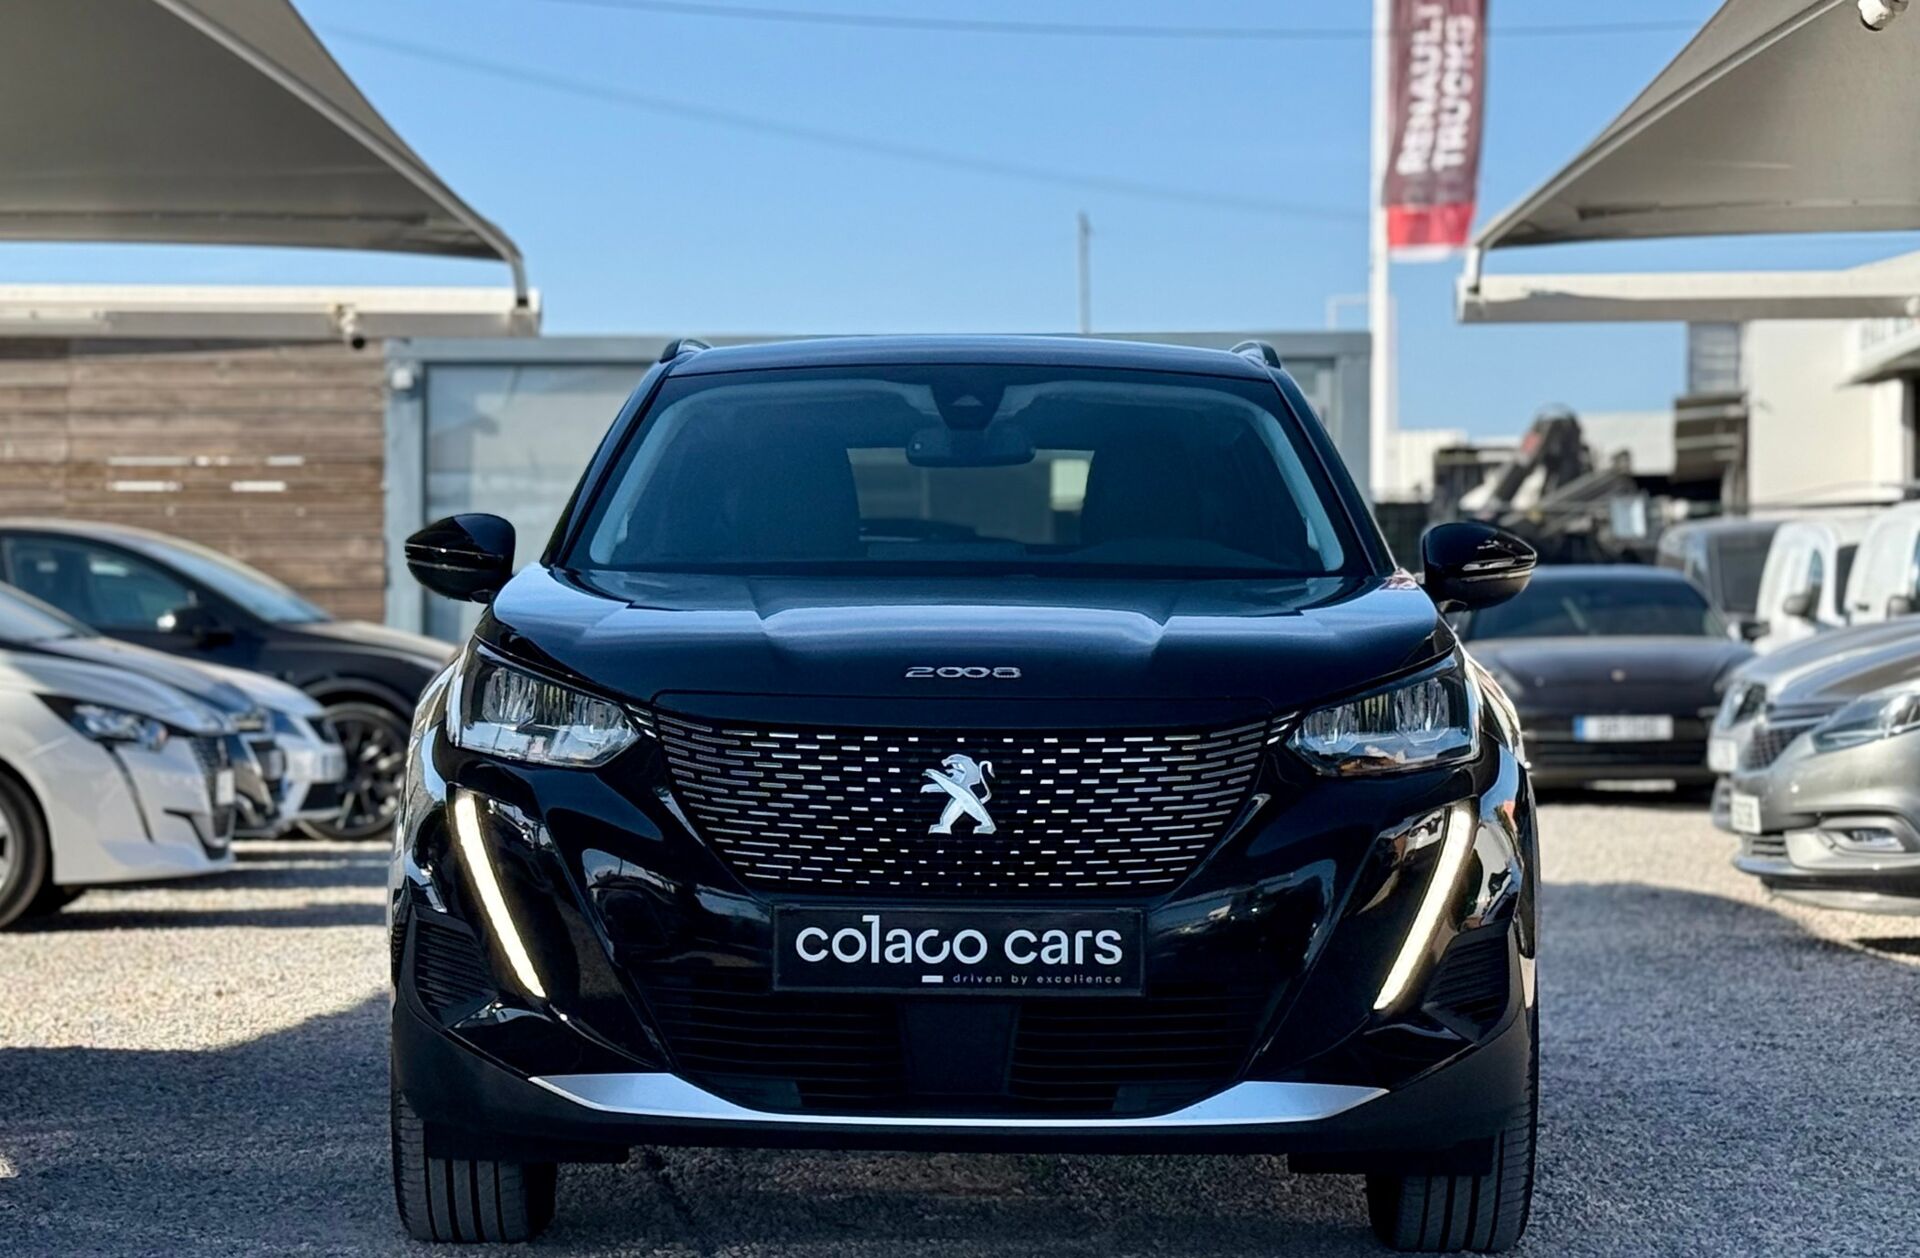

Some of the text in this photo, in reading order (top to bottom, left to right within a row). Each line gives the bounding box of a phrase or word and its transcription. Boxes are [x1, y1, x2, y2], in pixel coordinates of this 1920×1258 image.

[1395, 2, 1444, 176] RENAULT
[1430, 14, 1476, 172] TRUCKS
[904, 666, 1022, 679] 2008
[1003, 929, 1123, 965] cars
[952, 974, 1003, 984] driven
[1011, 974, 1028, 986] by
